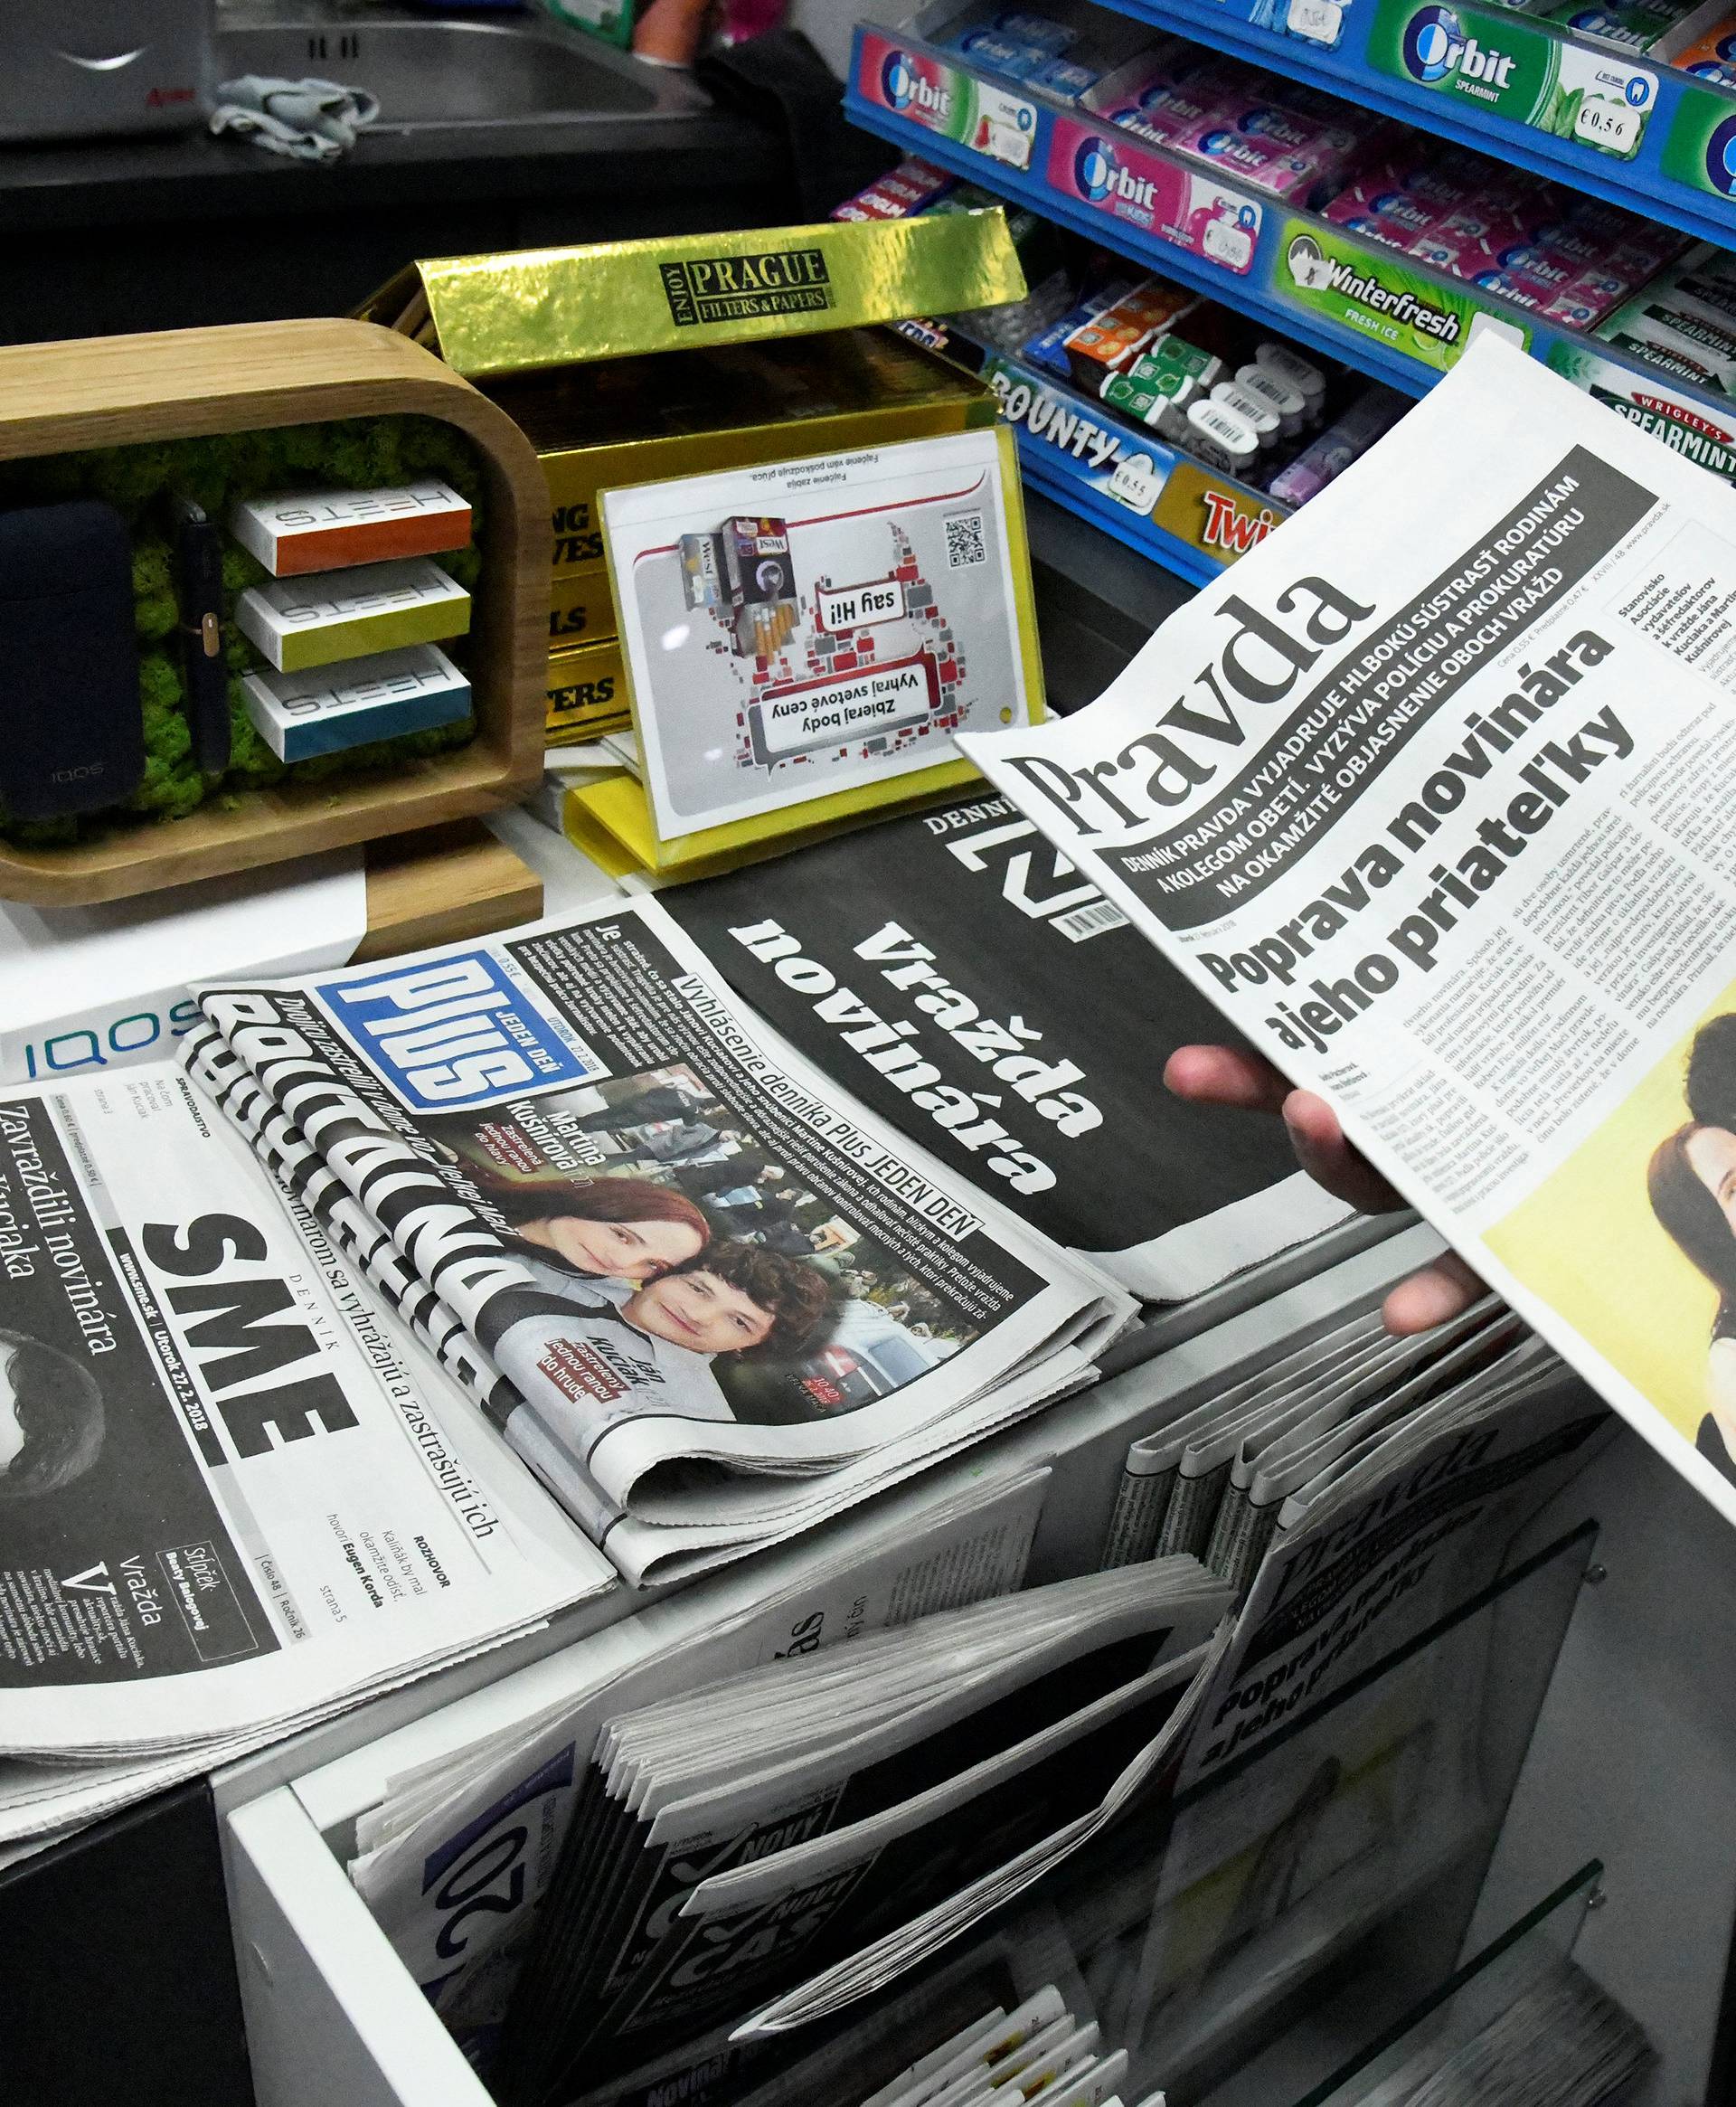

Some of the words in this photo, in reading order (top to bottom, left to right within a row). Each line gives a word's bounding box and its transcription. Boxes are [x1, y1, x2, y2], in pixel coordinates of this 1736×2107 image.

[1403, 5, 1516, 90] Orbit
[881, 50, 951, 116] Orbit
[1454, 79, 1501, 104] SPEARMINT
[1074, 137, 1157, 212] Orbit
[665, 267, 694, 323] ENJOY
[690, 251, 826, 295] PRAGUE
[1326, 257, 1460, 342] Winterfresh
[702, 298, 759, 319] FILTERS
[760, 300, 770, 314] &
[1345, 307, 1379, 332] FRESH
[1379, 318, 1399, 341] ICE
[992, 372, 1122, 468] BOUNTY
[1641, 395, 1722, 441] WRIGLEY'S
[1203, 490, 1282, 554] Twi
[829, 599, 857, 627] Hi!
[861, 591, 896, 613] say
[1618, 572, 1665, 617] Stanovisko
[1629, 585, 1670, 625] Asociácie
[1640, 581, 1693, 633] vydavateľov
[1668, 611, 1699, 641] vražde
[1694, 593, 1717, 614] Jána
[1674, 621, 1708, 656] Kuciaka
[810, 684, 869, 711] svetové
[872, 672, 920, 698] Vyhraj
[1121, 846, 1182, 874] DENNÍK
[1177, 798, 1253, 858] PRAVDA
[1243, 689, 1347, 800] VYJADRUJE
[1339, 623, 1419, 694] HLBOKÚ
[1410, 549, 1501, 631] SÚSTRASŤ
[1494, 474, 1580, 557] RODINÁM
[1172, 836, 1253, 891] KOLEGOM
[1247, 779, 1311, 838] OBETÍ.
[1305, 697, 1382, 776] VYZÝVA
[1373, 631, 1449, 702] POLÍCIU
[1444, 620, 1467, 640] A
[1456, 506, 1586, 629] PROKURATÚRU
[770, 701, 807, 721] ceny
[802, 709, 835, 733] body
[838, 697, 896, 724] Zbieraj
[1001, 576, 1377, 836] Pravda
[1215, 874, 1249, 899] NA
[1244, 783, 1343, 880] OKAMŽITÉ
[1335, 670, 1448, 789] OBJASNENIE
[1439, 610, 1510, 676] OBOCH
[1500, 566, 1564, 622] VRÁŽD
[1195, 844, 1405, 993] Poprava
[1386, 629, 1617, 854] novinára
[1275, 953, 1400, 1054] jeho
[1387, 704, 1635, 973] priateľky
[495, 1012, 531, 1050] JEDEN
[529, 1049, 564, 1075] DEŇ
[546, 1016, 577, 1044] UTOROK
[595, 922, 626, 940] Je
[679, 1008, 707, 1035] Jánovi
[792, 1125, 826, 1152] Martine
[727, 919, 1058, 1195] novinára
[852, 920, 1105, 1139] Vražda
[175, 1077, 211, 1139] SPRAVODAJSTVO
[679, 978, 768, 1072] Vyhlásenie
[760, 1072, 832, 1128] denníka
[826, 1122, 872, 1157] Plus
[864, 1154, 933, 1204] JEDEN
[922, 1196, 976, 1235] DEŇ
[475, 1131, 488, 1145] do
[484, 1140, 510, 1168] hlavy
[479, 1121, 509, 1149] jednou
[505, 1146, 532, 1174] ranou
[500, 1124, 544, 1167] Zastrelená
[505, 1101, 580, 1171] Kušnírová
[545, 1110, 609, 1167] Martina
[0, 1106, 79, 1230] Zavraždili
[44, 1231, 117, 1356] novinára
[118, 1252, 159, 1320] www.sme.sk
[154, 1330, 182, 1373] Utorok
[184, 1402, 209, 1432] 2018
[143, 1213, 360, 1460] SME
[541, 1355, 561, 1371] do
[553, 1365, 586, 1400] hrude
[547, 1339, 584, 1375] jednou
[580, 1369, 614, 1401] ranou
[571, 1340, 627, 1391] zastrelený
[325, 1268, 349, 1289] sa
[337, 1289, 404, 1384] vyhrážajú
[389, 1384, 410, 1399] a
[400, 1401, 479, 1504] zastrašujú
[460, 1496, 495, 1539] ich
[343, 1542, 367, 1575] Eugen
[361, 1574, 384, 1610] Korda
[359, 1531, 390, 1574] okamžite
[401, 1563, 415, 1577] by
[408, 1575, 428, 1596] mal
[413, 1535, 452, 1589] ROZHOVOR
[119, 1554, 164, 1627] Vražda
[319, 1584, 343, 1616] strana
